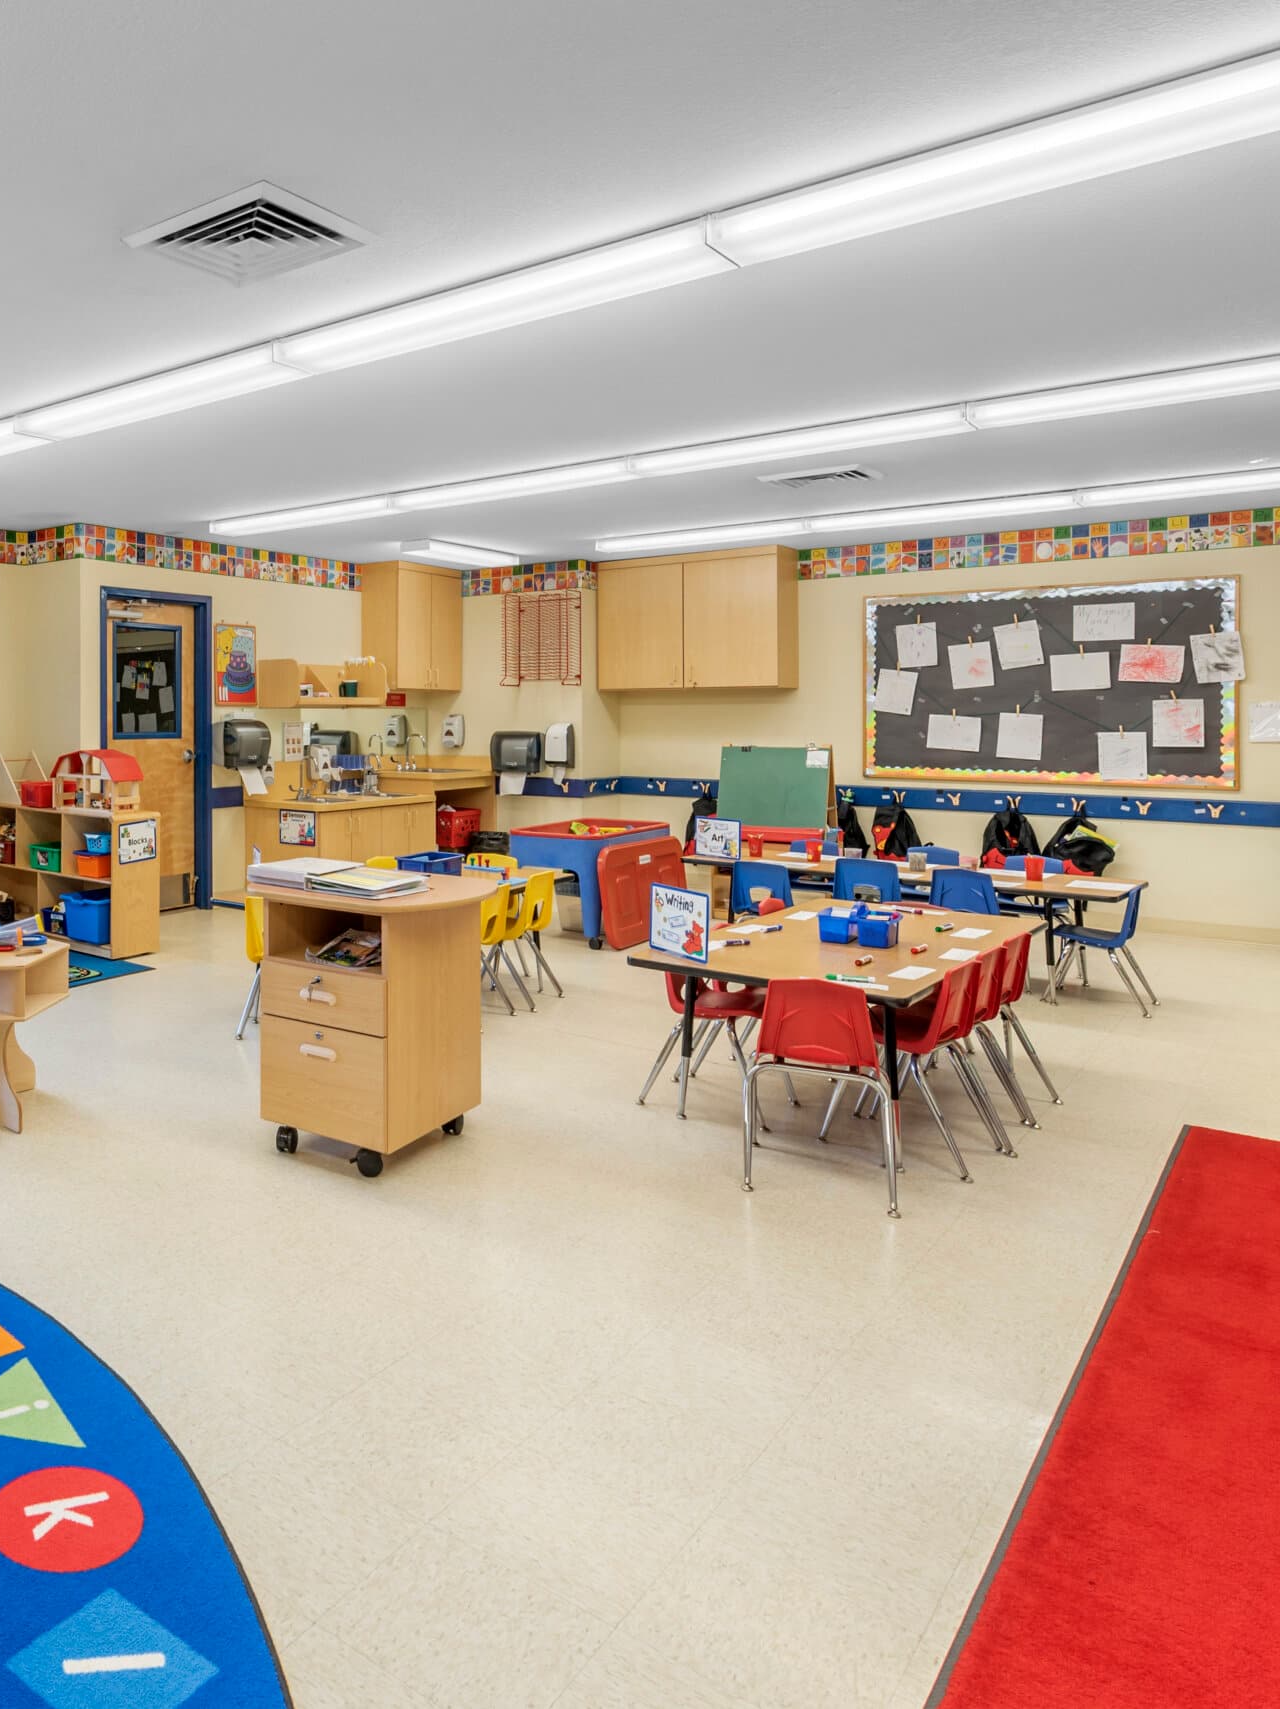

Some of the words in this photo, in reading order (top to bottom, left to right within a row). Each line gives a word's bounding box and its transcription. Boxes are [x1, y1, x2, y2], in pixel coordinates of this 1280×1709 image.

[128, 836, 148, 846] Blocks
[711, 833, 724, 842] Art
[664, 892, 694, 914] Writing
[24, 1492, 110, 1542] k
